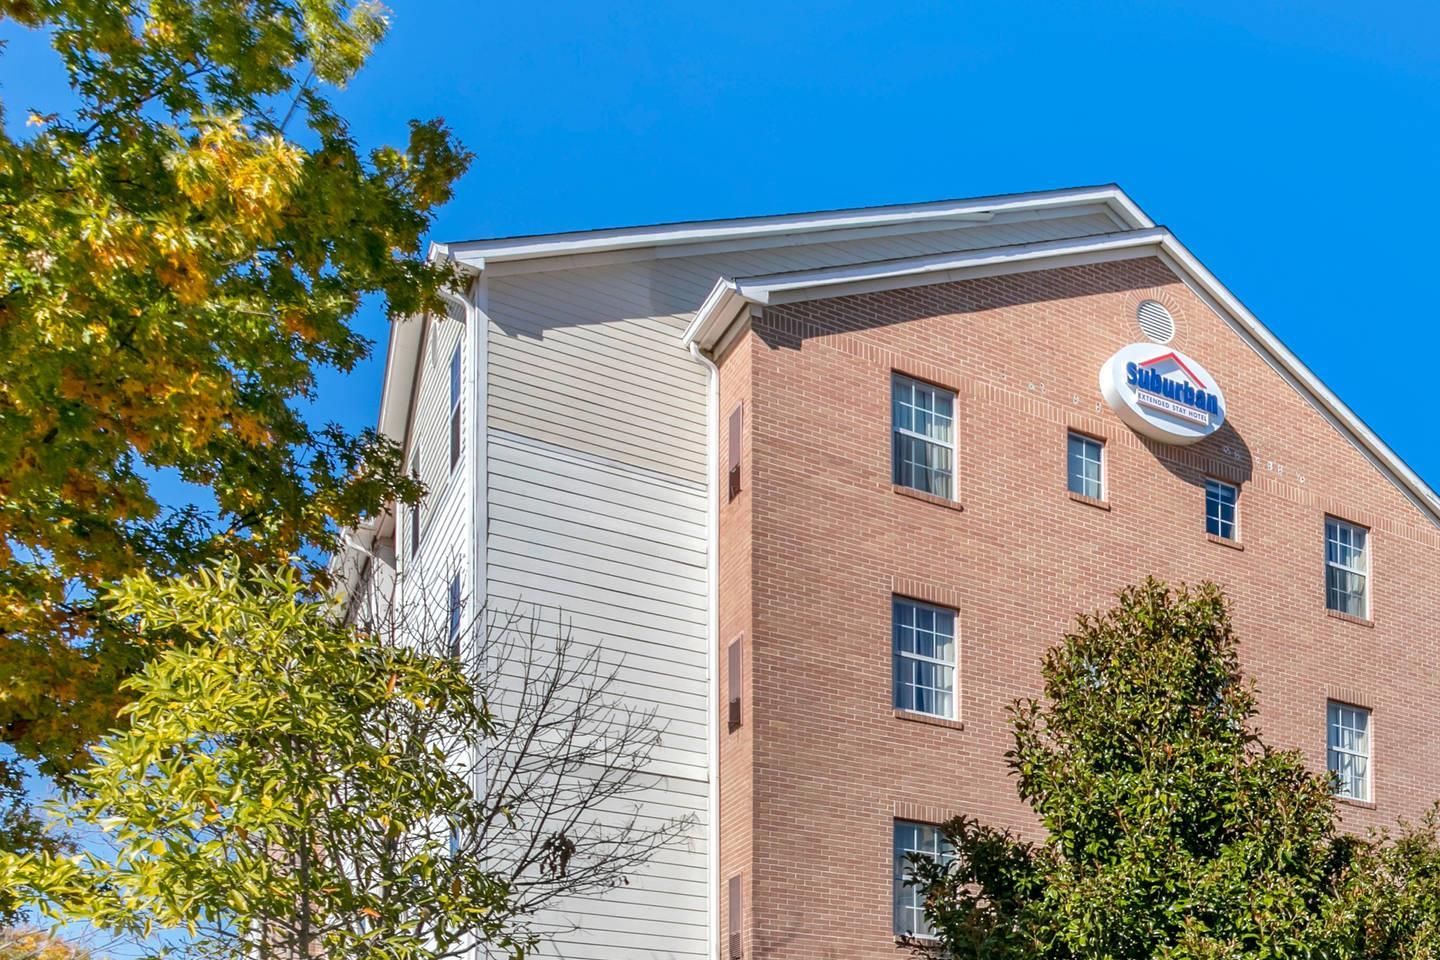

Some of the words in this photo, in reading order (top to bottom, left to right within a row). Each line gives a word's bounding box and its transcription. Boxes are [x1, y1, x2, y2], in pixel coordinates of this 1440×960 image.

[1127, 361, 1218, 415] Suburban
[1138, 393, 1170, 409] EXTENDED
[1172, 405, 1186, 415] STAY
[1188, 411, 1207, 422] HOTEL
